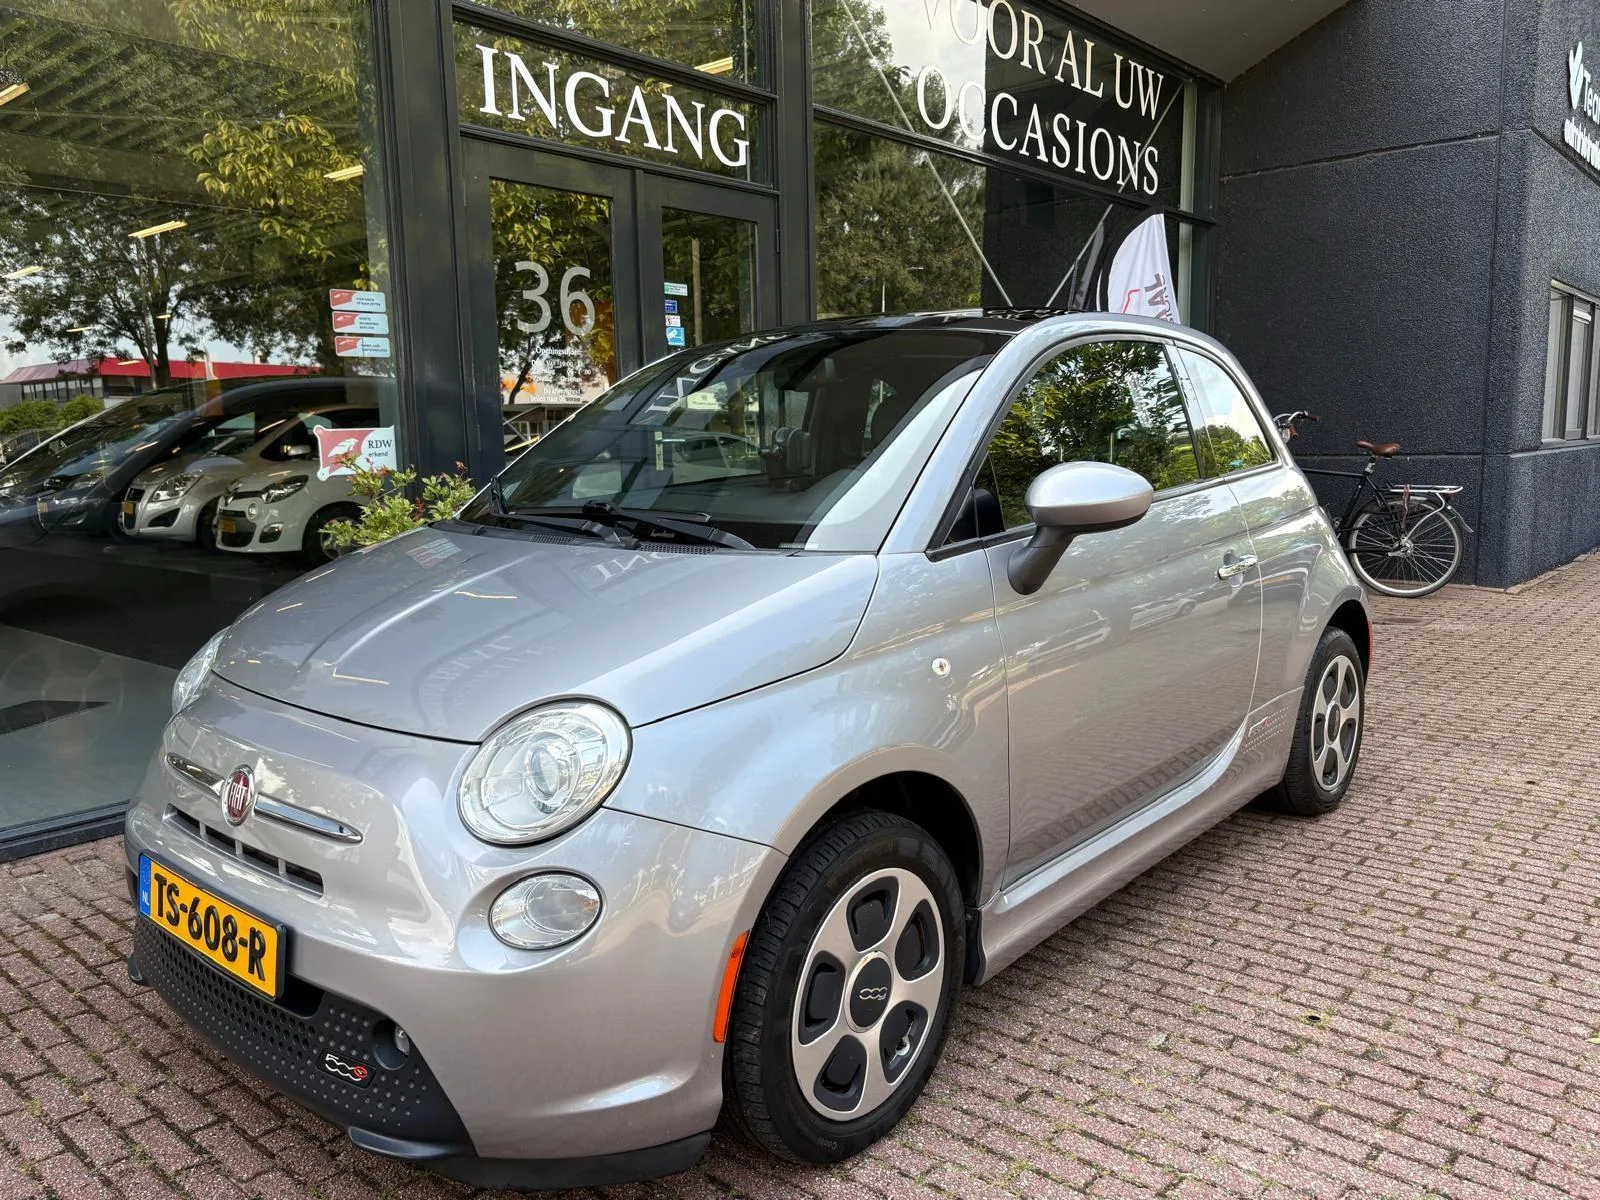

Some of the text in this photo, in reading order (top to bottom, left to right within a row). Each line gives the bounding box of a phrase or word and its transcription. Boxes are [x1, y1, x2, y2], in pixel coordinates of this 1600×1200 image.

[475, 43, 750, 168] INGANG
[1054, 30, 1104, 98] AL
[1113, 52, 1164, 121] UW
[917, 65, 1159, 195] OCCASIONS
[514, 261, 596, 336] 36
[368, 439, 393, 449] RDW
[228, 781, 248, 811] FIAT
[153, 872, 266, 982] TS-608-R
